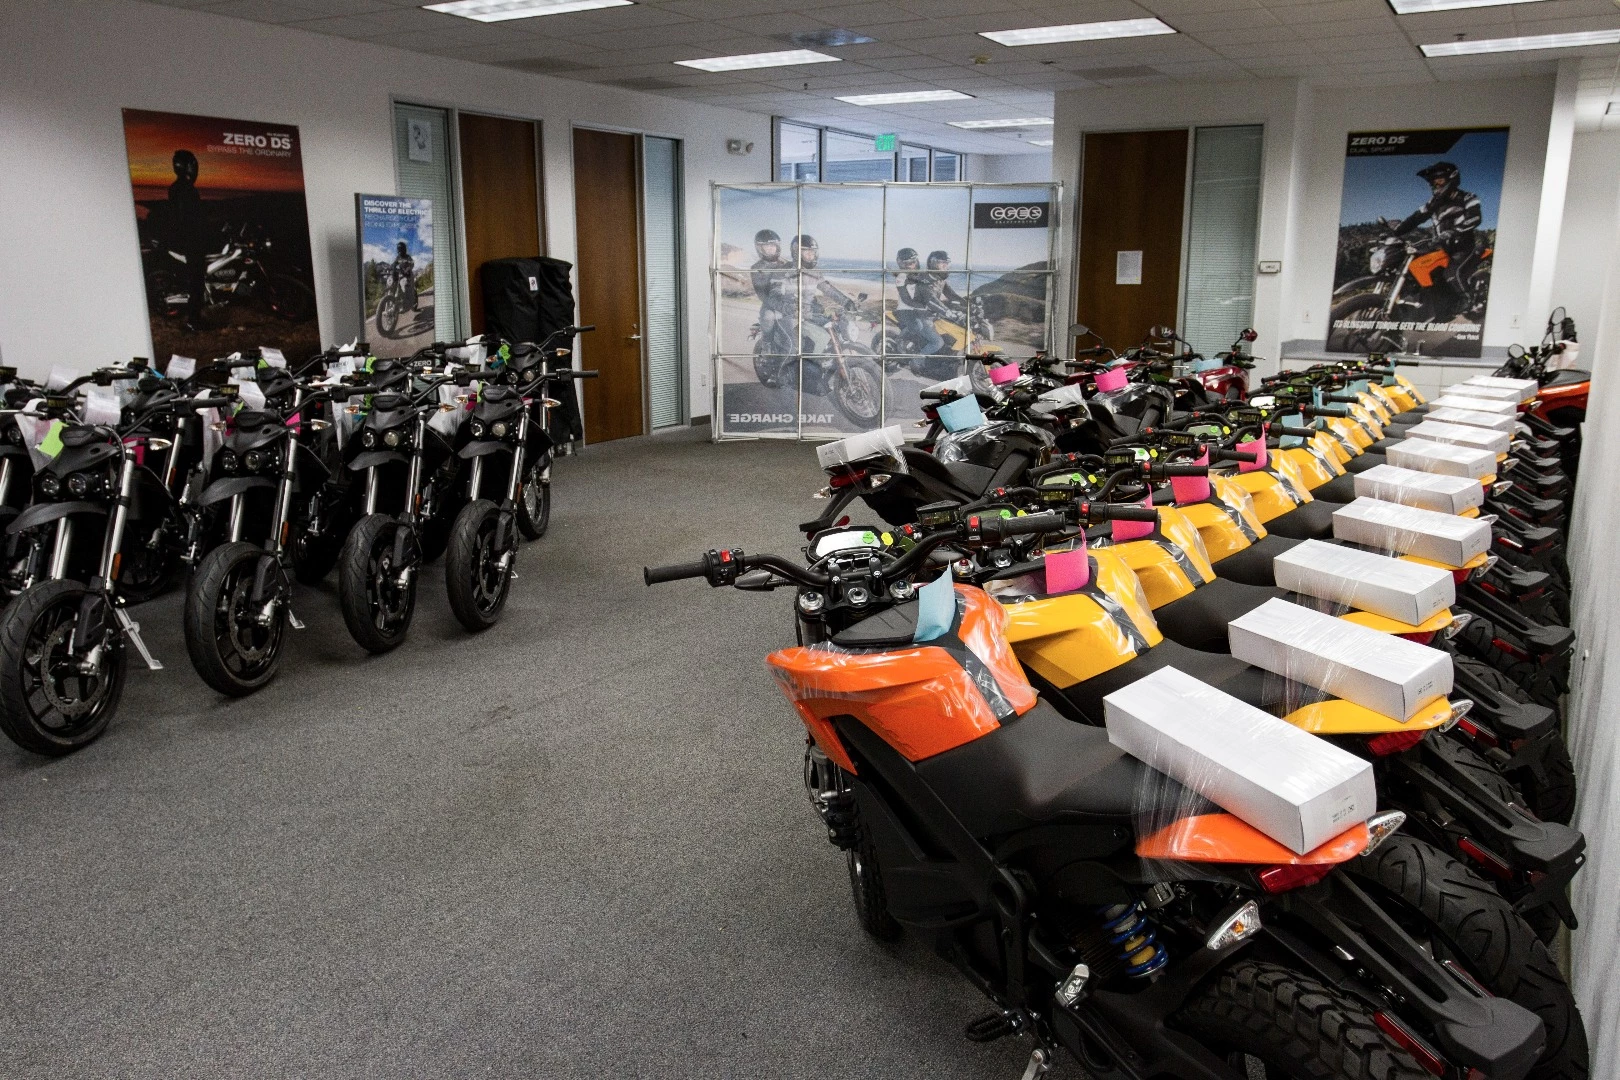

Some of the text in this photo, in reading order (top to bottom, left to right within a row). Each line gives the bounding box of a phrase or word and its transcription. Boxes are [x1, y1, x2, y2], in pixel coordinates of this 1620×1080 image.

[223, 132, 292, 150] ZERO DS
[1351, 135, 1407, 146] ZERO DS
[239, 147, 254, 156] THE
[255, 148, 292, 158] ORDINARY
[1370, 145, 1395, 153] SPORT
[364, 200, 412, 209] DISCOVER THE
[364, 206, 427, 216] THRILL OF ELECTRIC
[1399, 321, 1416, 331] GETS
[1415, 322, 1428, 331] THE
